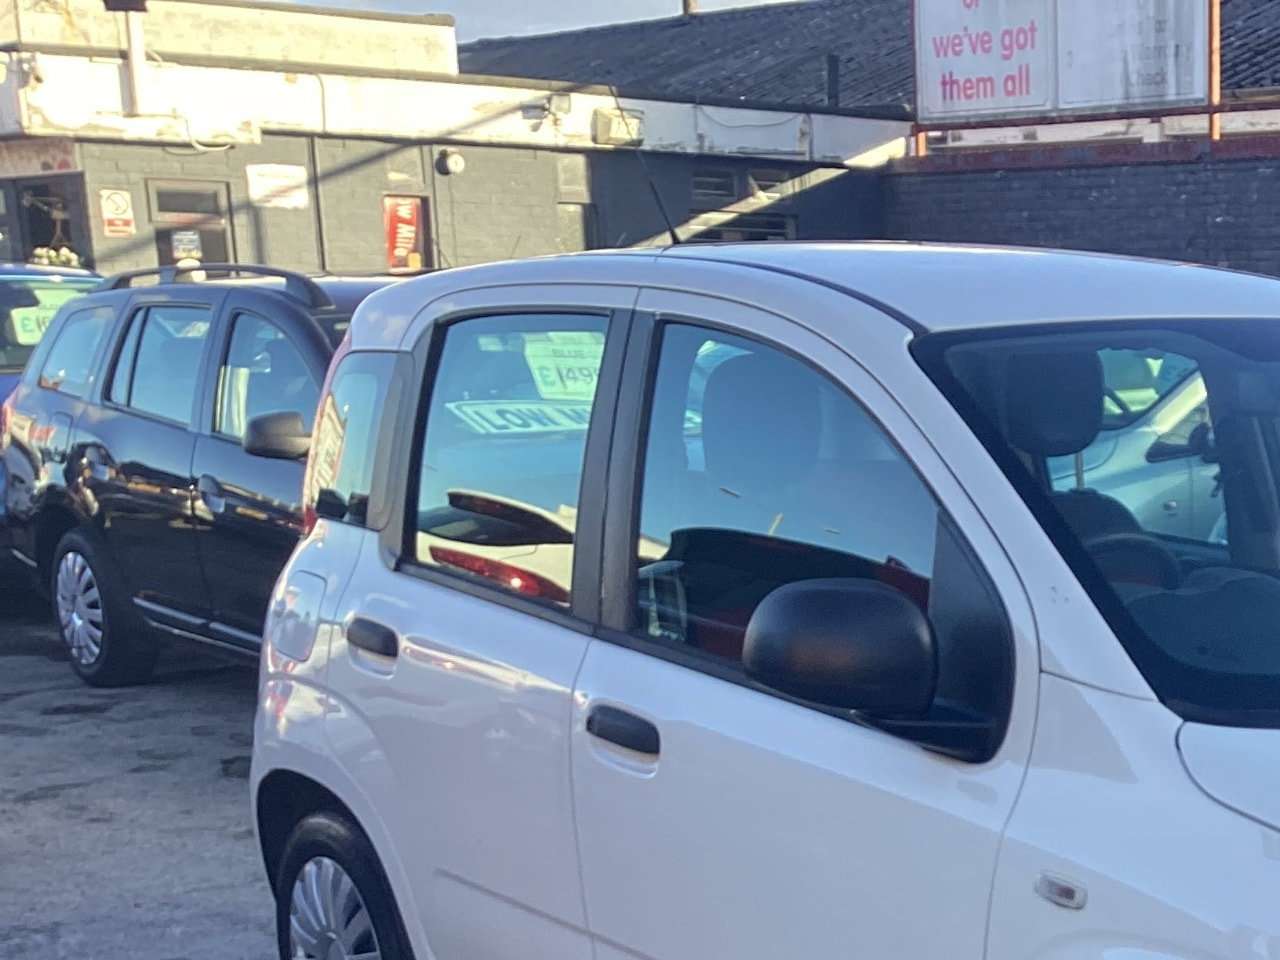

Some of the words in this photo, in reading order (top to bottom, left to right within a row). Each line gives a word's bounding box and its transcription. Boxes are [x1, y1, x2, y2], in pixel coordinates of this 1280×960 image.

[932, 26, 993, 58] we've
[1001, 19, 1037, 60] got
[941, 70, 995, 100] them
[1003, 63, 1030, 97] all
